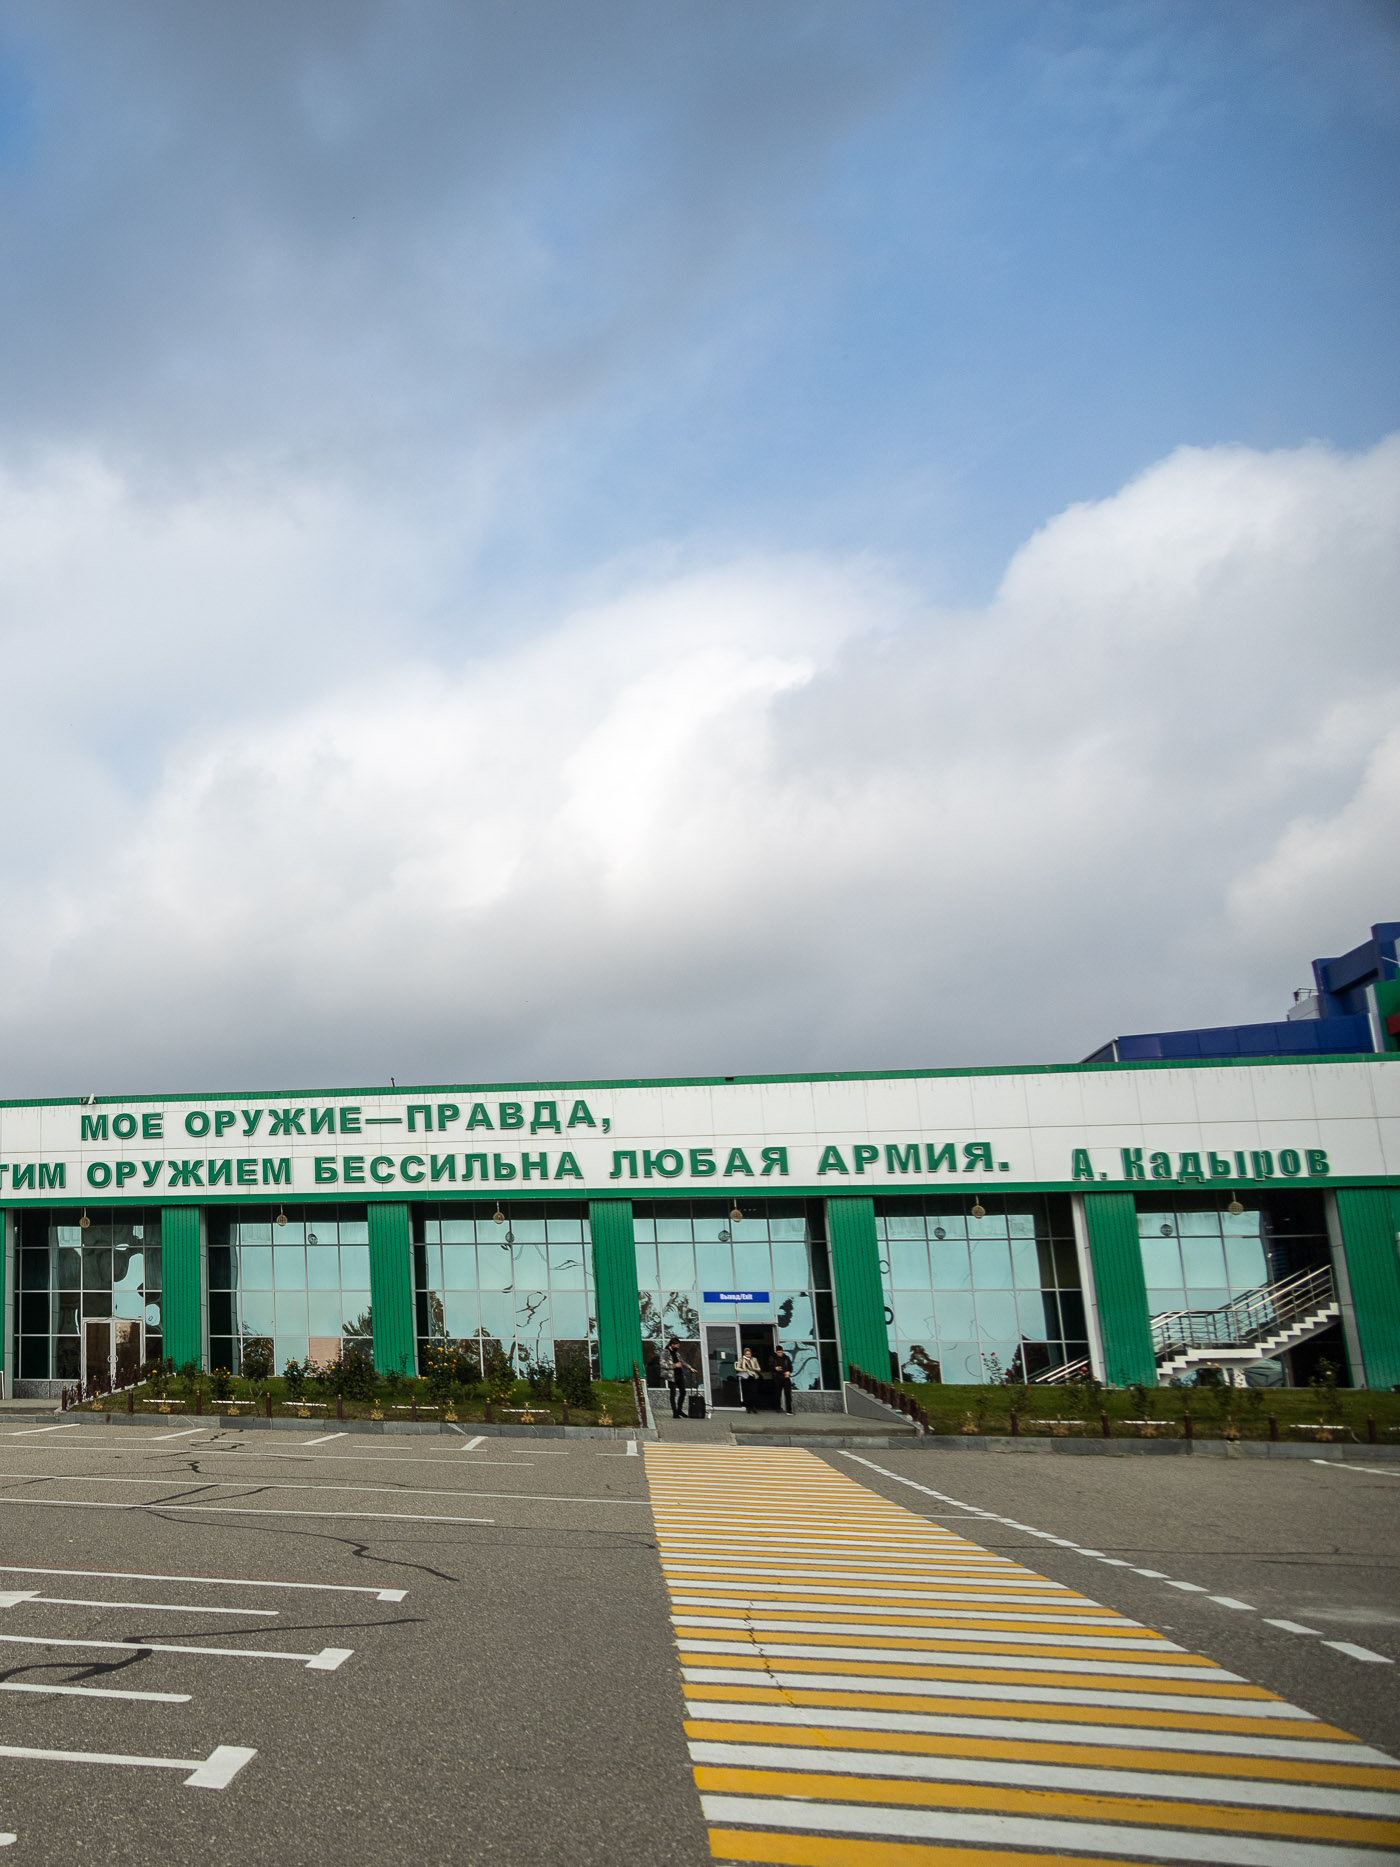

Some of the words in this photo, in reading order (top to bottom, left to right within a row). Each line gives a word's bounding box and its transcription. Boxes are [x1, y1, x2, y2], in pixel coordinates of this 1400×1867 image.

[80, 1111, 165, 1141] МОЕ
[86, 1157, 292, 1189] ОРУЖИЕМ
[314, 1151, 583, 1185] БЕССИЛЬНА
[609, 1146, 790, 1179] ЛЮБАЯ
[817, 1141, 1010, 1176] АРМИЯ.
[1072, 1148, 1107, 1180] А.
[1120, 1147, 1331, 1183] Кадыров
